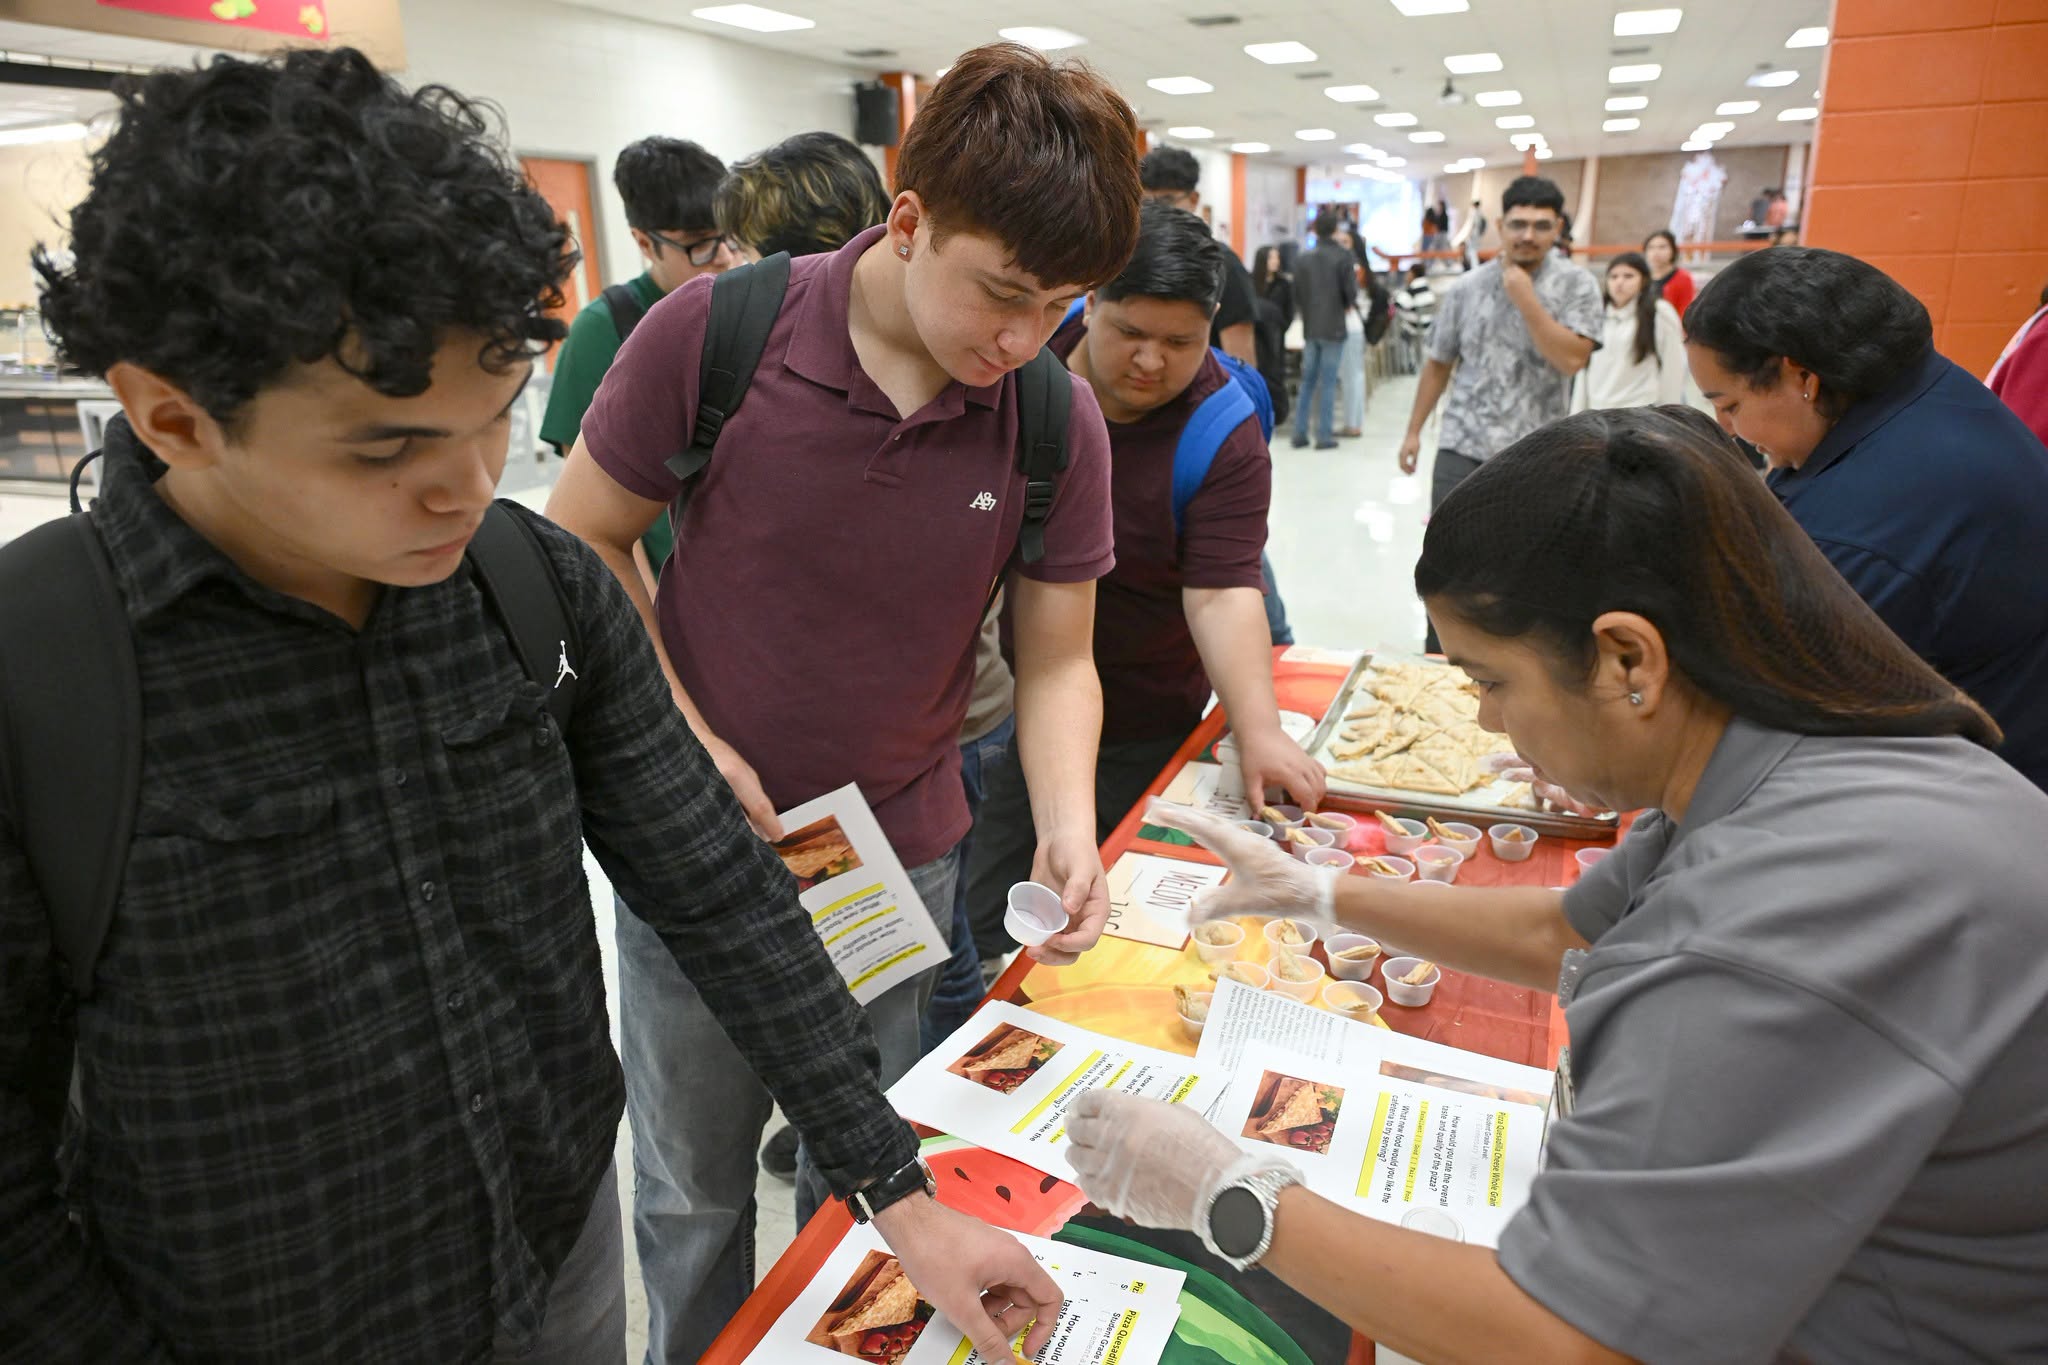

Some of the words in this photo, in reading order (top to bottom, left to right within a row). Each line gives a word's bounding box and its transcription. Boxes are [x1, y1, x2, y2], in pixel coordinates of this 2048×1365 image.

[1146, 870, 1208, 911] MELON
[1088, 1054, 1110, 1074] cafeteria
[1098, 1063, 1114, 1076] What
[1136, 1066, 1150, 1078] taste
[1088, 1077, 1100, 1086] new
[1126, 1079, 1138, 1089] and
[1140, 1075, 1154, 1087] How
[1185, 1075, 1198, 1087] Pizza
[1053, 1087, 1076, 1108] serving?
[1388, 1095, 1398, 1119] cafeteria
[1400, 1106, 1409, 1120] What
[1441, 1106, 1449, 1119] taste
[1049, 1113, 1061, 1123] you
[1452, 1116, 1460, 1128] How
[1485, 1114, 1493, 1132] Student
[1498, 1112, 1506, 1124] Pizza
[1039, 1123, 1053, 1132] like
[1383, 1127, 1392, 1135] try
[1397, 1121, 1405, 1133] new
[1029, 1133, 1042, 1141] the
[1394, 1134, 1404, 1147] food
[1434, 1132, 1444, 1152] quality
[1495, 1125, 1504, 1152] Quesadilla
[1378, 1136, 1389, 1162] serving?
[1390, 1148, 1399, 1166] would
[1432, 1160, 1441, 1170] the
[1493, 1152, 1502, 1171] Cheese
[1387, 1167, 1395, 1179] you
[1429, 1171, 1438, 1191] pizza?
[1443, 1173, 1452, 1183] the
[1385, 1180, 1394, 1191] like
[1491, 1173, 1500, 1190] Whole
[1382, 1193, 1391, 1203] the
[1440, 1185, 1449, 1207] overall
[1490, 1191, 1498, 1207] Grain
[1057, 1299, 1073, 1320] taste
[1065, 1314, 1081, 1333] How
[1104, 1312, 1121, 1338] Student
[1122, 1310, 1137, 1328] Pizza
[1051, 1335, 1069, 1361] would
[1078, 1326, 1102, 1365] Elementa
[1094, 1339, 1108, 1359] Grade
[1106, 1330, 1128, 1365] Quesadill
